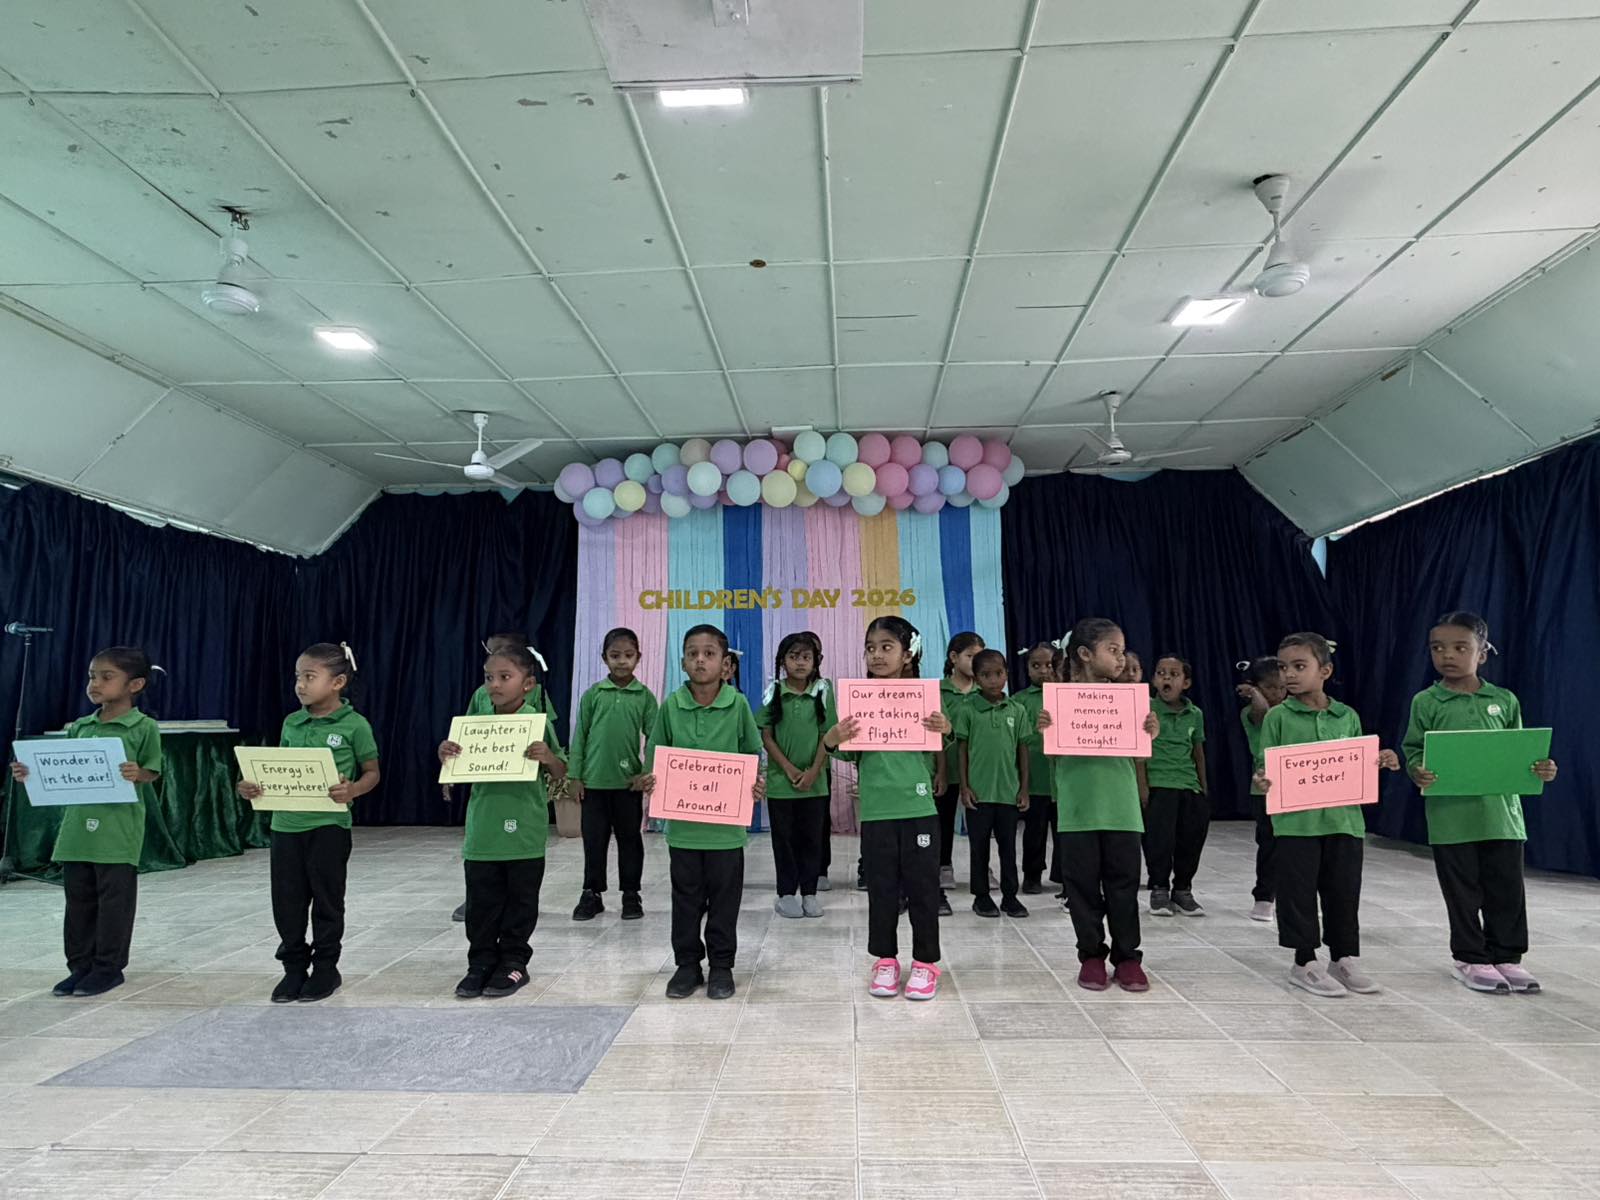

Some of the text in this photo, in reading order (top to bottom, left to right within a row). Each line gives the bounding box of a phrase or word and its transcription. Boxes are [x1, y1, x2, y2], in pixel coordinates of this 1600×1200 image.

[638, 584, 917, 610] CHILDREN'S DAY 2026
[851, 688, 922, 699] Our dreams
[1077, 691, 1114, 703] Making
[855, 707, 920, 723] are taking
[1073, 707, 1119, 715] memories
[464, 724, 527, 739] Laughter is
[1070, 720, 1123, 733] today and
[868, 726, 907, 743] flight!
[469, 742, 515, 754] the best
[1077, 736, 1117, 748] tonight!
[39, 754, 105, 766] Wonder is
[669, 758, 742, 775] Celebration
[1285, 752, 1359, 770] Everyone is
[261, 763, 315, 778] Energy is
[44, 772, 110, 784] in the air!
[1298, 777, 1306, 785] a
[260, 781, 327, 795] Everywhere!
[689, 780, 719, 793] is all
[676, 798, 727, 813] Around!
